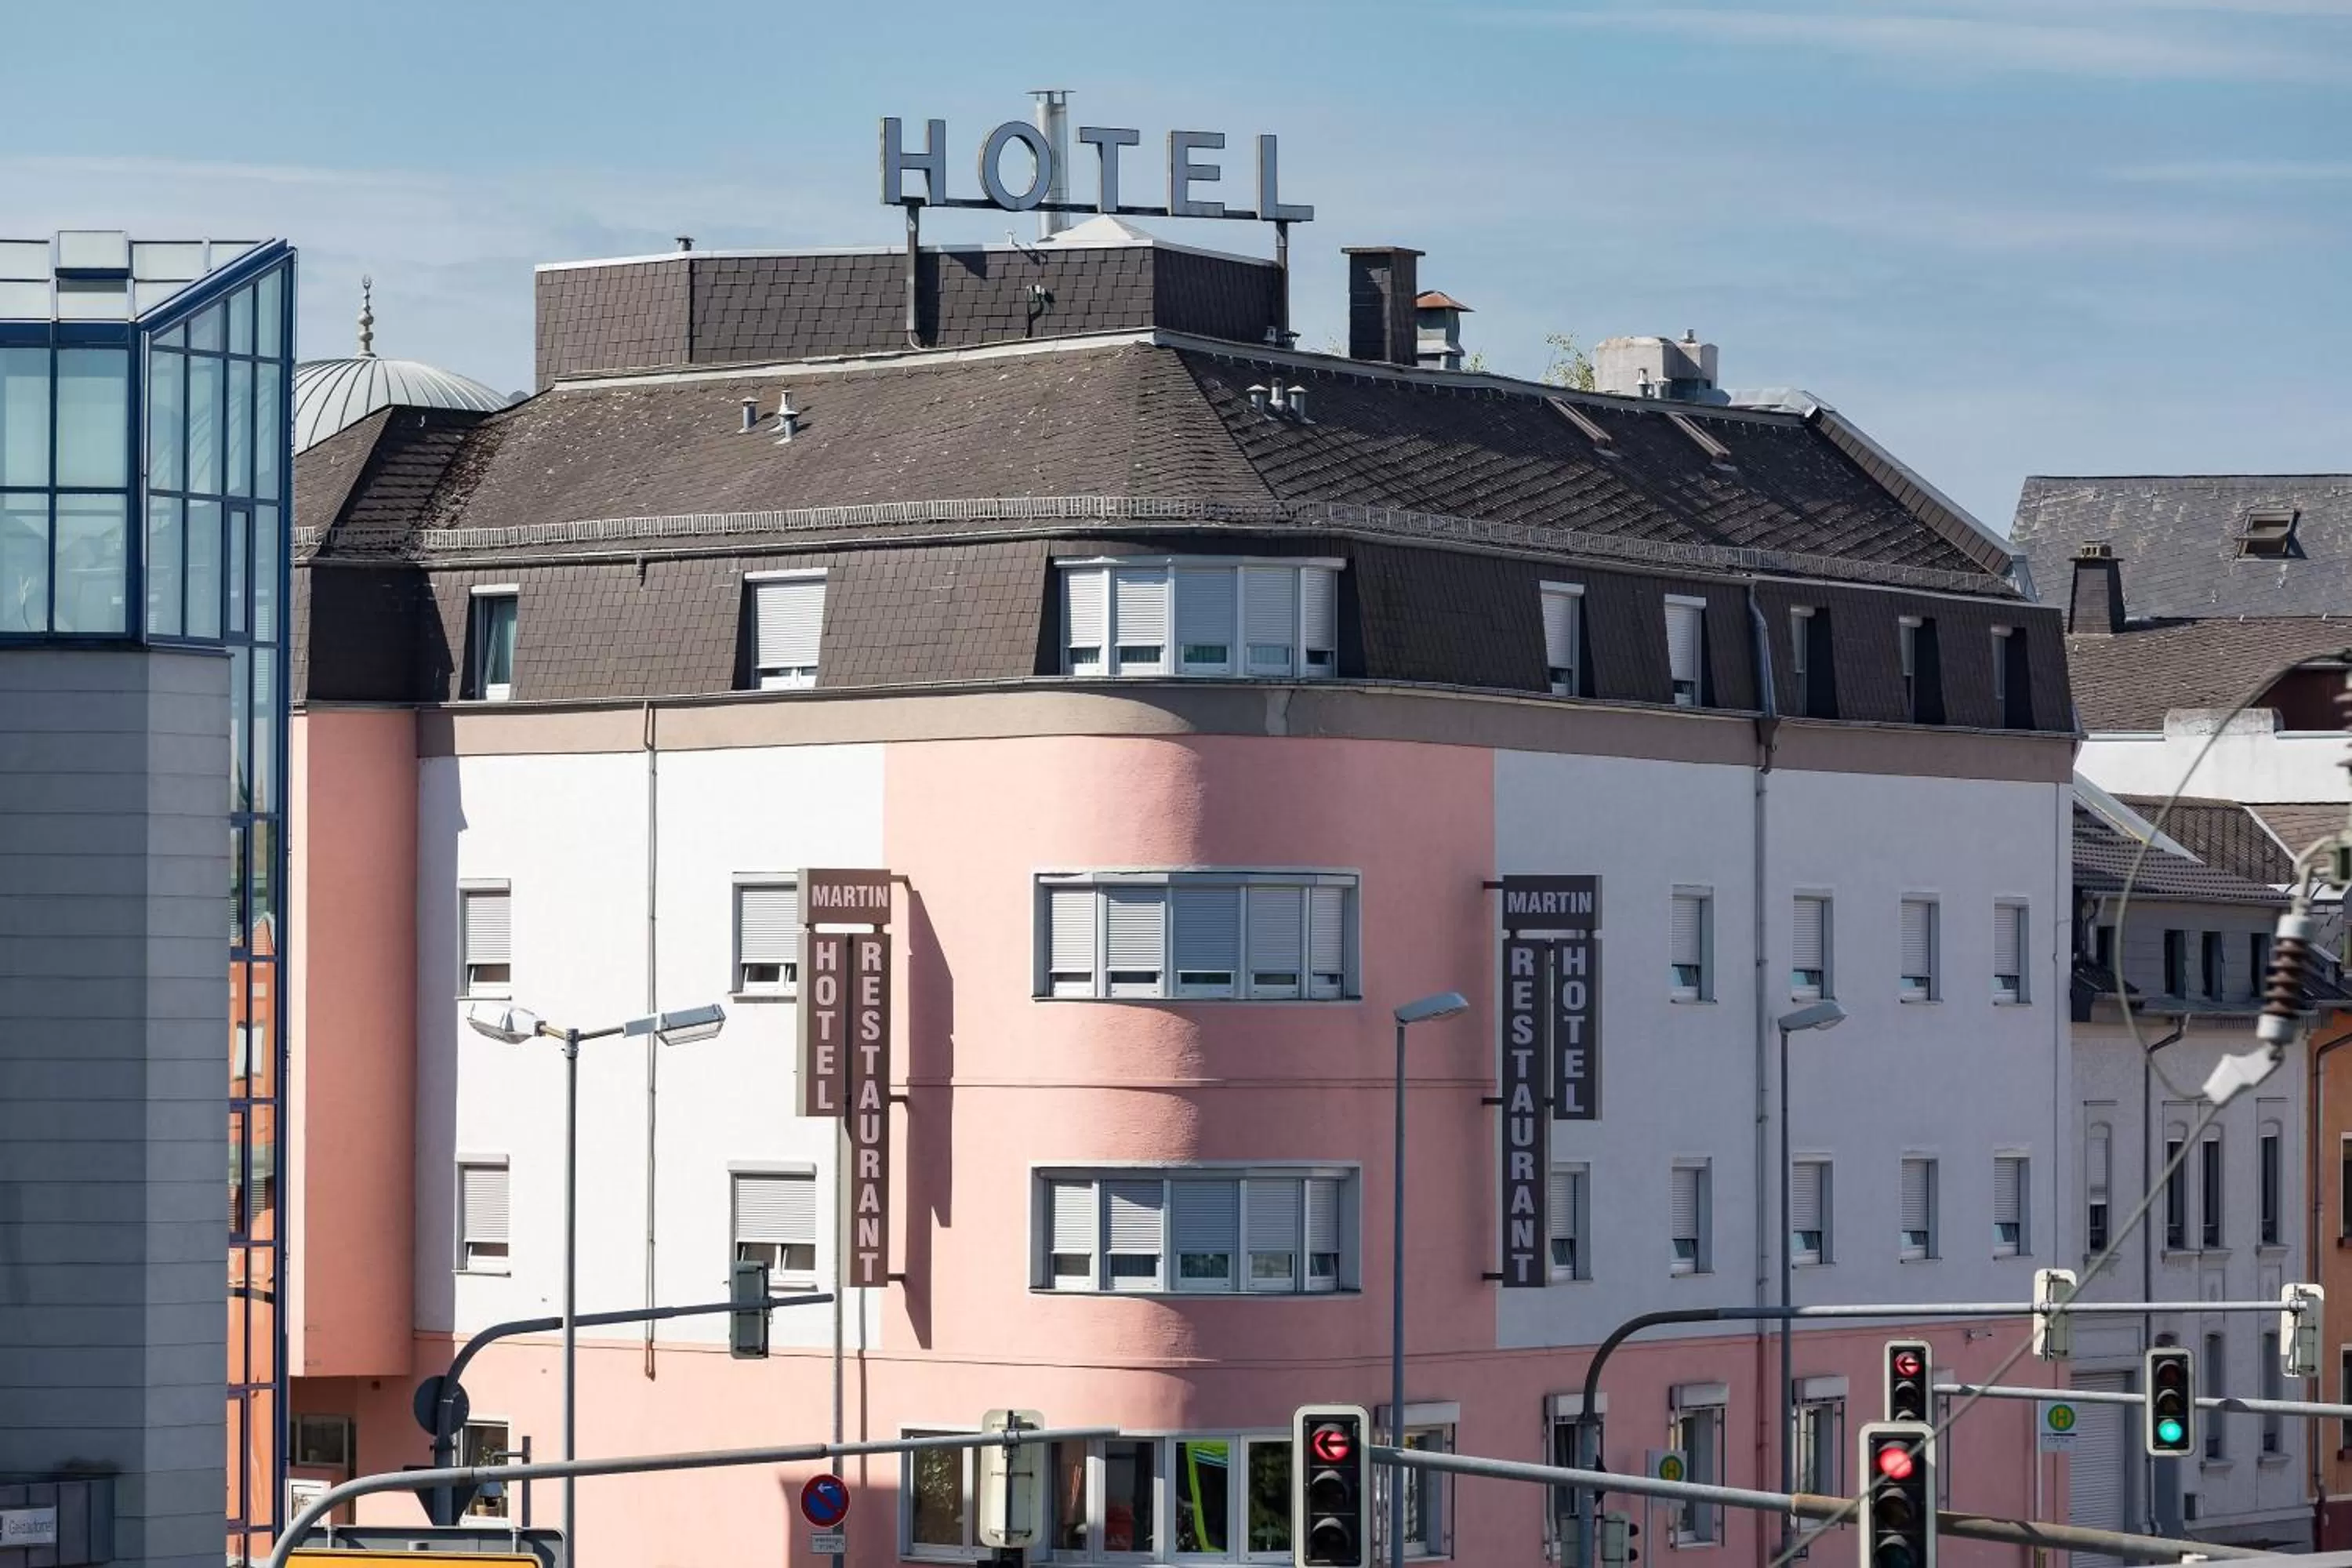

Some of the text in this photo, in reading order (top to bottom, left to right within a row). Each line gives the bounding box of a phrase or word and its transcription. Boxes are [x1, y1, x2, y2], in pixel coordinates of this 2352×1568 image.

[880, 117, 1314, 222] HOTEL
[811, 884, 888, 907] MARTIN
[1508, 891, 1592, 913] MARTIN
[815, 942, 837, 1110] HOTEL
[1562, 946, 1587, 1113] HOTEL
[858, 942, 882, 1283] RESTAURANT
[1510, 946, 1535, 1283] RESTAURANT
